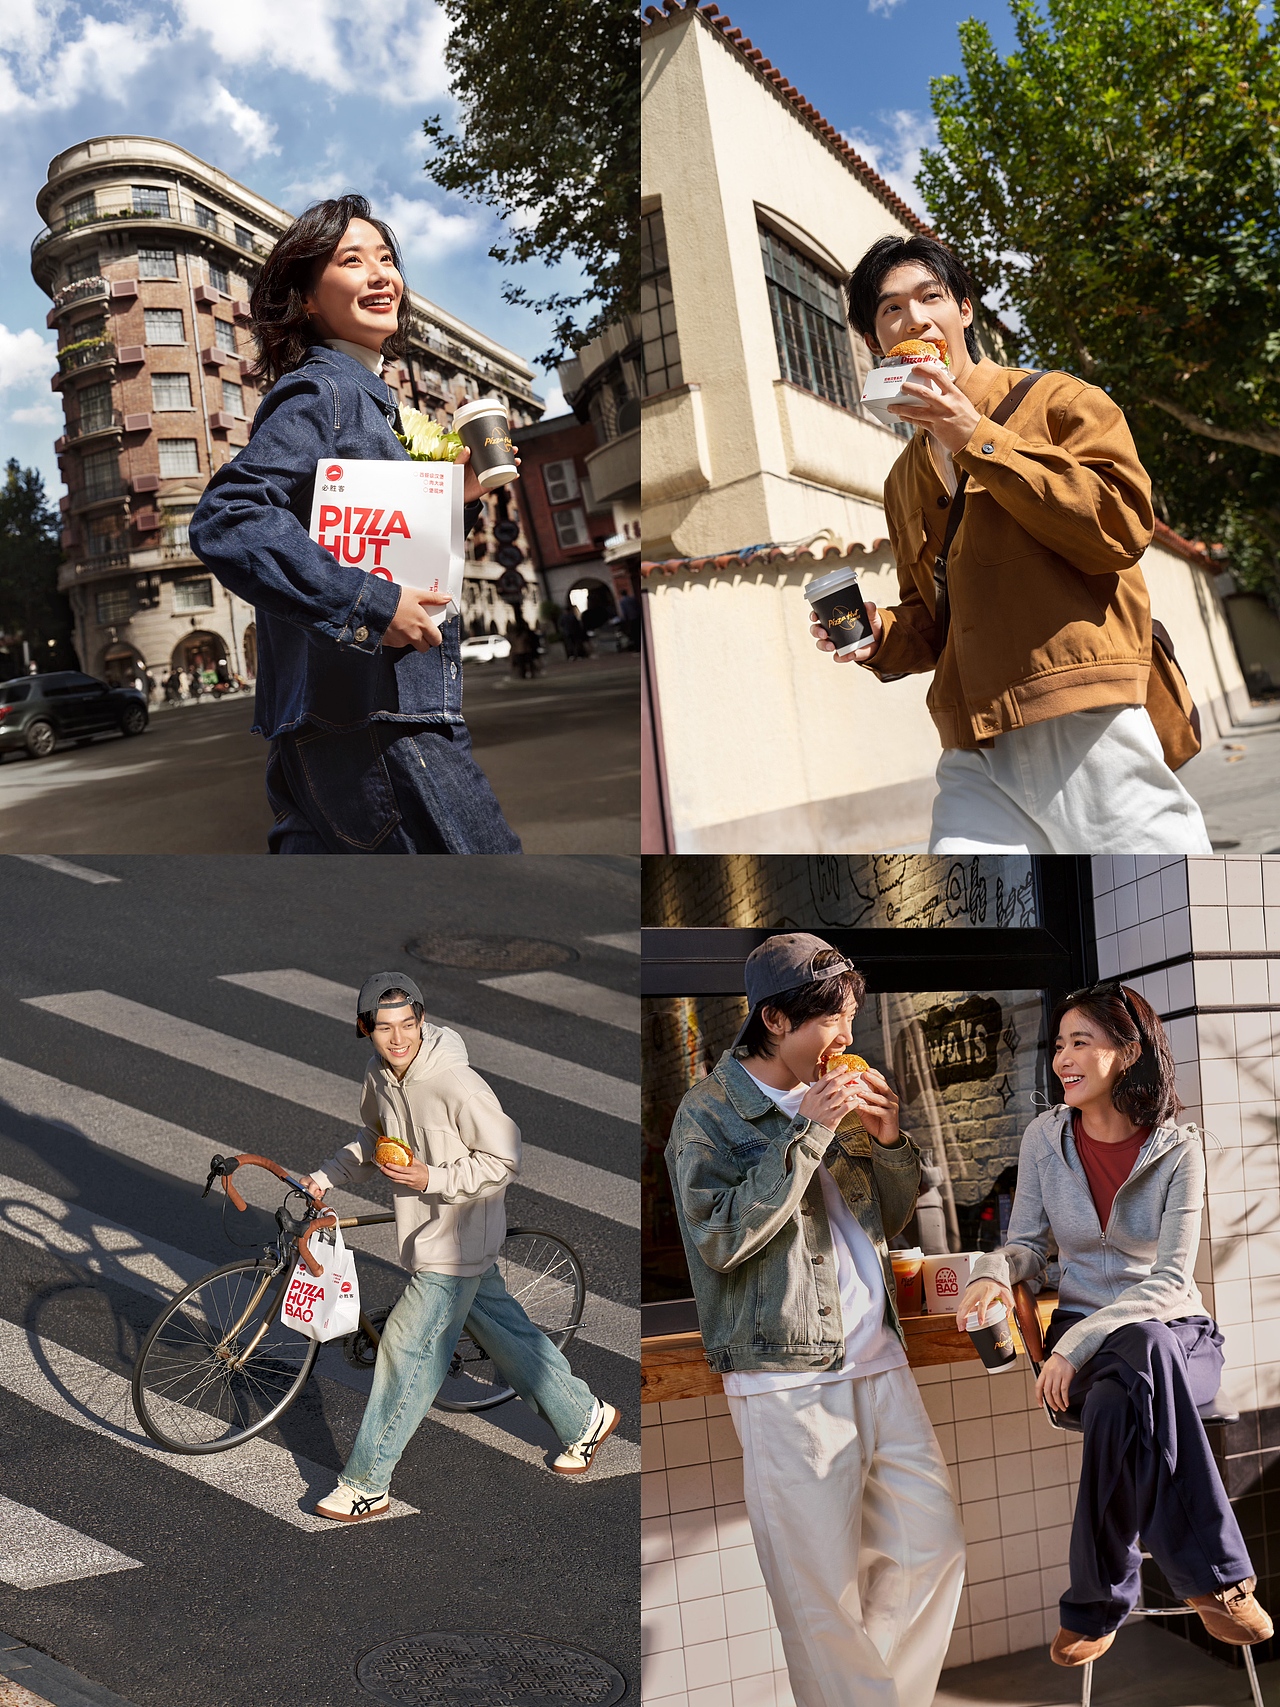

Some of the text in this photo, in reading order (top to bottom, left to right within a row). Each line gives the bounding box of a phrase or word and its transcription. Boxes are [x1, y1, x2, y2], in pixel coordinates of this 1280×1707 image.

[900, 355, 923, 364] Pizza
[484, 437, 503, 447] Pizza
[504, 436, 512, 444] Hu
[322, 484, 345, 492] 必胜客
[319, 505, 412, 539] PIZZA
[318, 534, 390, 566] HUT
[828, 614, 846, 629] Pizza
[290, 1279, 325, 1301] PIZZA
[936, 1283, 958, 1293] BAO
[286, 1291, 317, 1309] HUT
[285, 1303, 314, 1323] BAO
